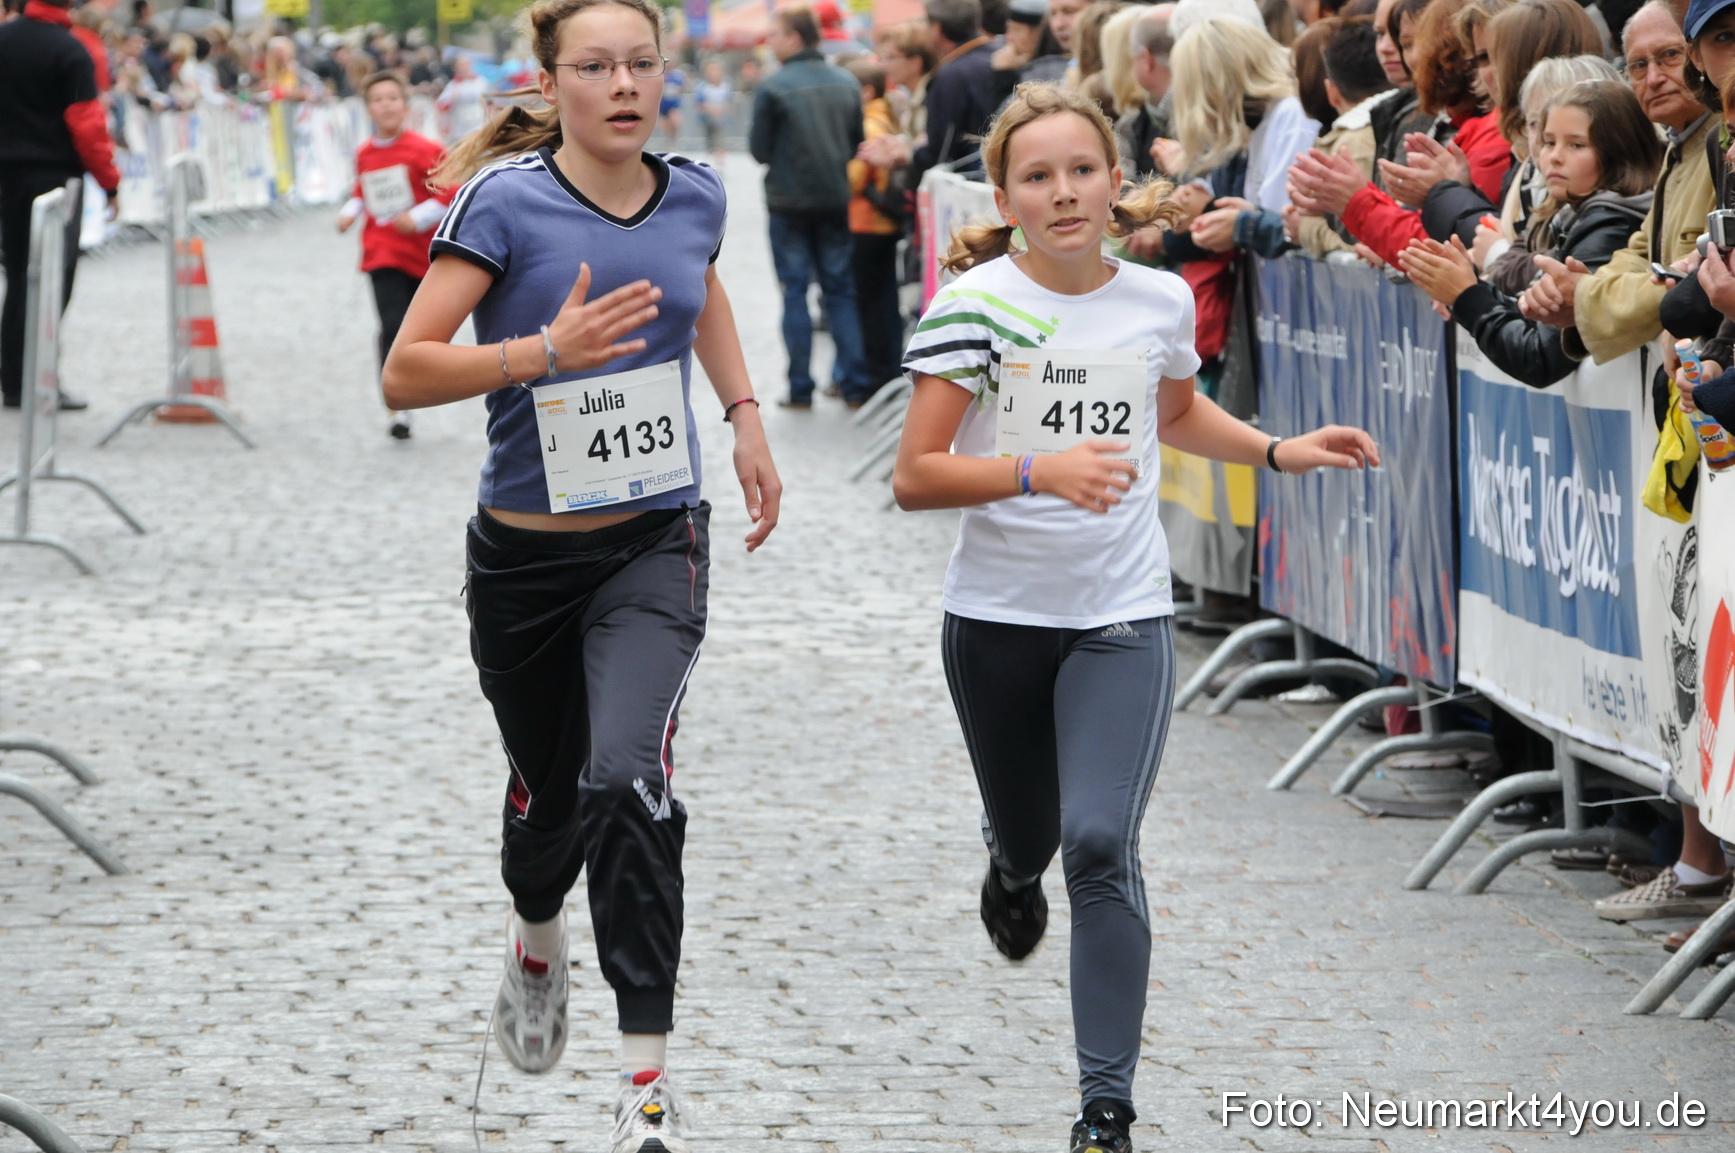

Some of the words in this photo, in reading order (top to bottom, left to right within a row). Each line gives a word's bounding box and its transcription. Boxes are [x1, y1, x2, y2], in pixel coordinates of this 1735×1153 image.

[1042, 360, 1087, 384] Anne
[579, 388, 625, 415] Julia
[1004, 396, 1013, 412] J
[1041, 400, 1132, 435] 4132
[548, 434, 557, 452] J
[587, 415, 675, 463] 4133
[1700, 431, 1723, 443] Spezi
[644, 467, 690, 488] PFLEIDERER
[1101, 627, 1140, 638] adidas
